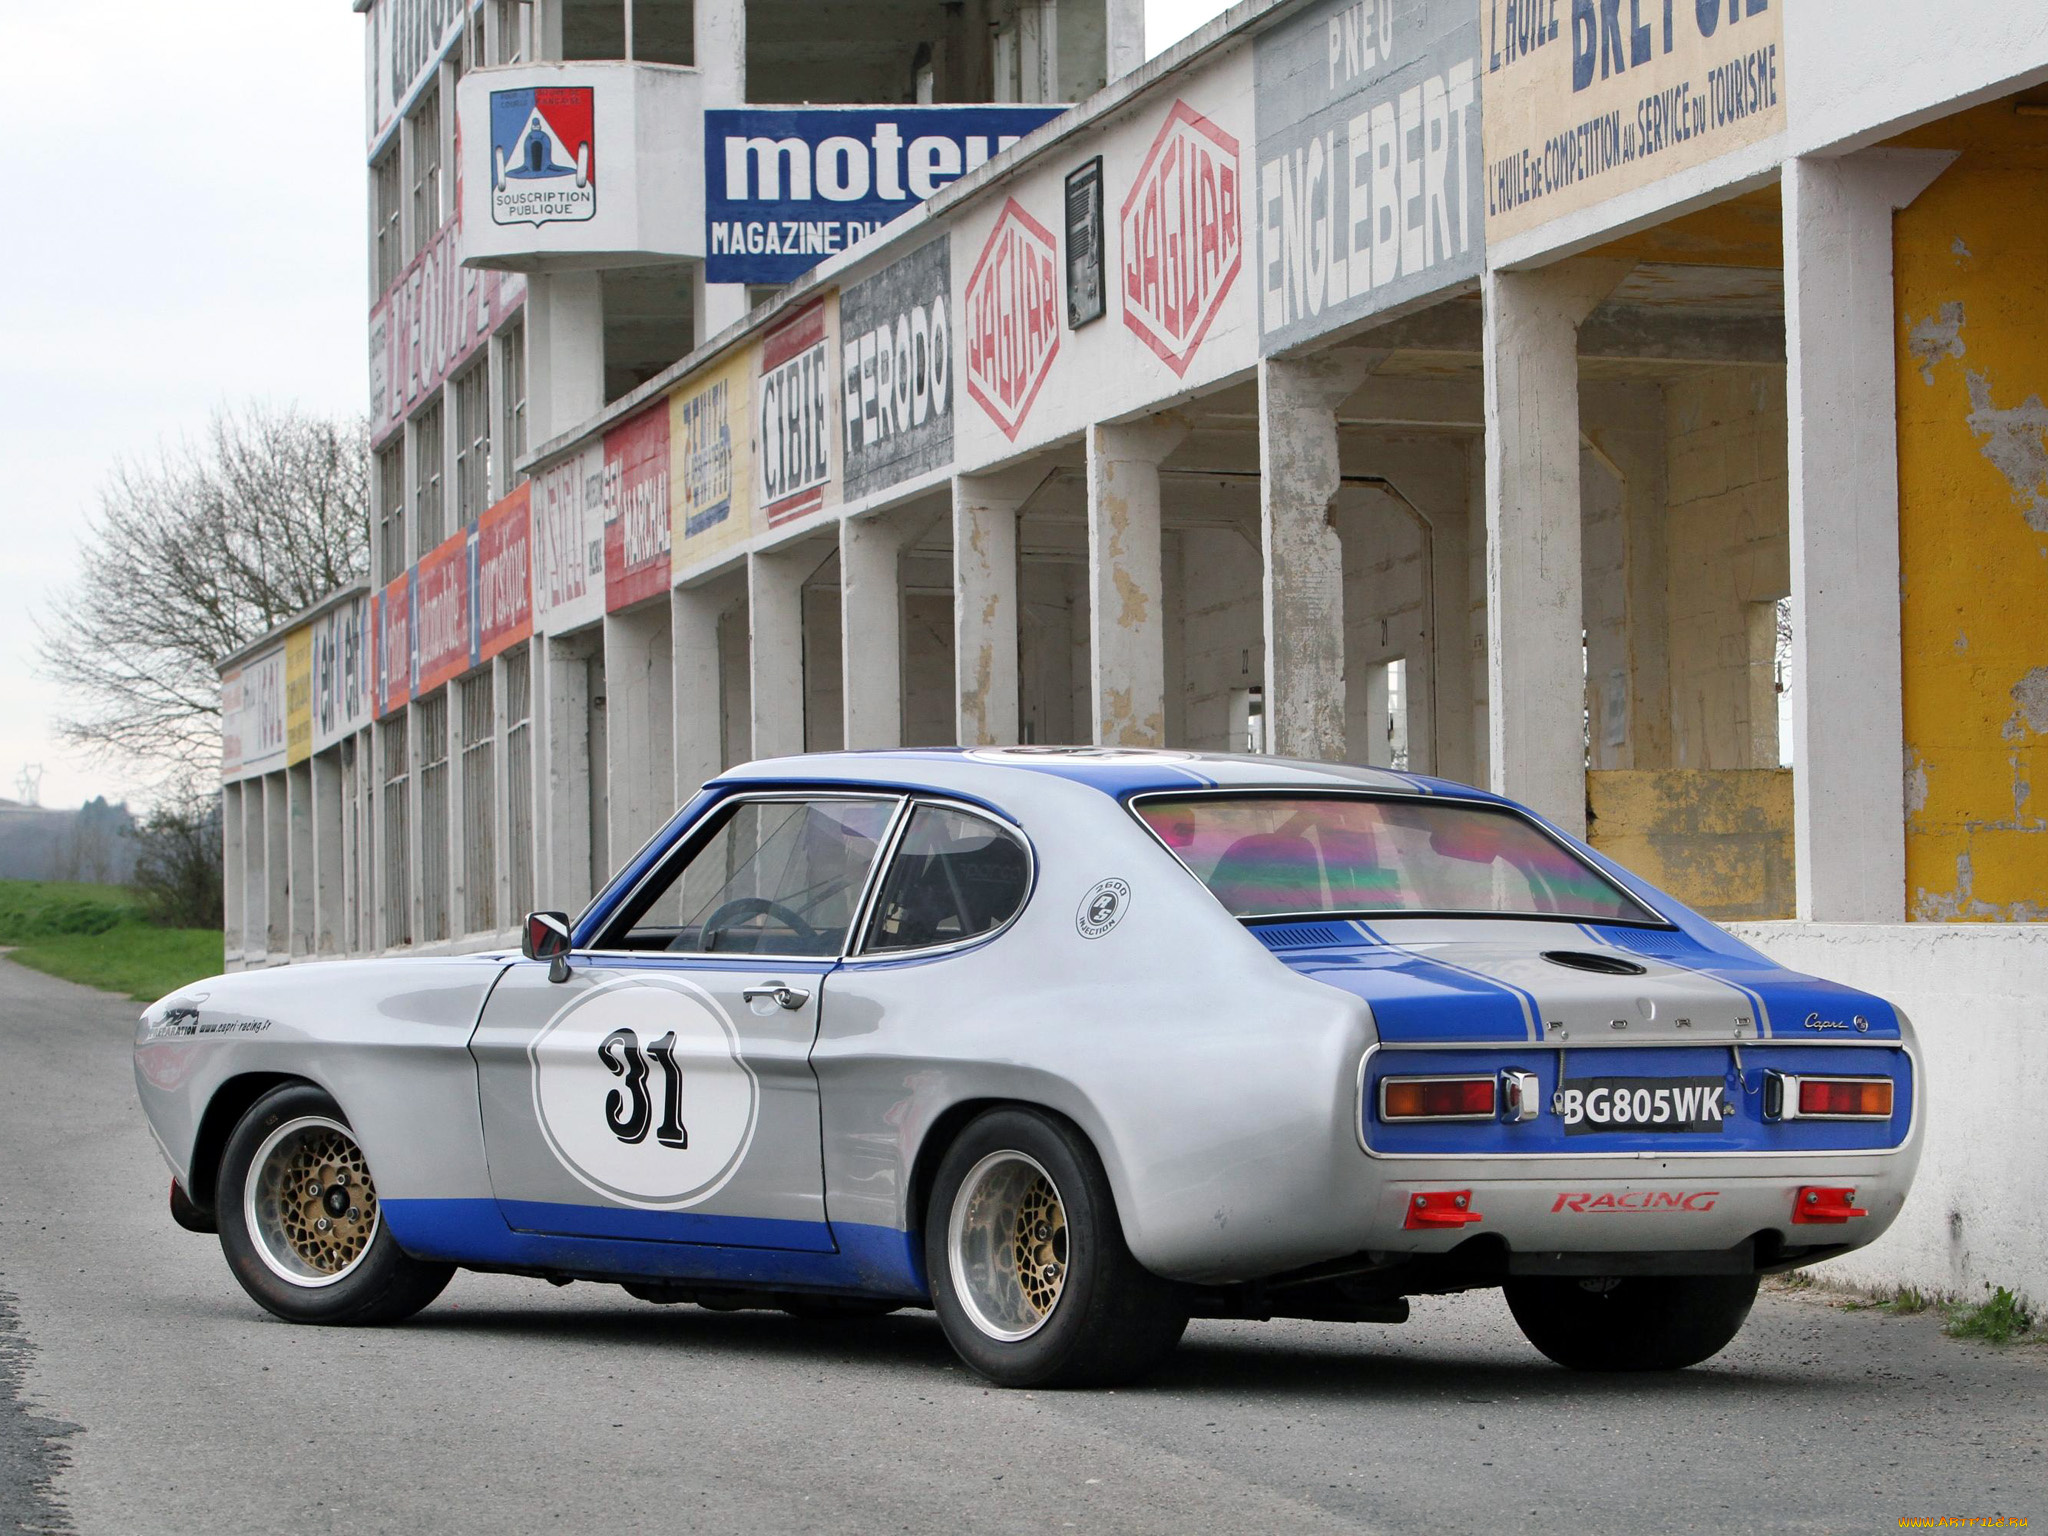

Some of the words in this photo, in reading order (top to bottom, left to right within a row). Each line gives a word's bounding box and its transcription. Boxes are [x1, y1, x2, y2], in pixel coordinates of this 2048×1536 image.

[1329, 0, 1393, 90] PNEU
[1489, 148, 1530, 217] L'HUILE
[1531, 157, 1542, 200] DE
[1544, 110, 1620, 195] COMPETITION
[1622, 122, 1635, 164] AU
[1638, 81, 1691, 159] SERVICE
[1692, 94, 1706, 138] DU
[1708, 43, 1777, 130] TOURISME
[496, 192, 590, 206] SOUSCRIPTION
[509, 204, 573, 216] PUBLIQUE
[1261, 58, 1475, 336] ENGLEBERT
[711, 221, 843, 255] MAGAZINE
[1126, 133, 1236, 341] JAGUAR
[969, 227, 1054, 410] JAGUAR
[843, 295, 948, 453] FERODO
[623, 470, 671, 569] MARCHAL
[1095, 881, 1127, 896] 2600
[1079, 916, 1116, 936] INJECTION
[1546, 1016, 1751, 1031] FORD
[1804, 1012, 1849, 1031] Capri
[598, 1027, 688, 1149] 31
[1564, 1086, 1724, 1125] BG805WK
[1550, 1191, 1721, 1213] RACING
